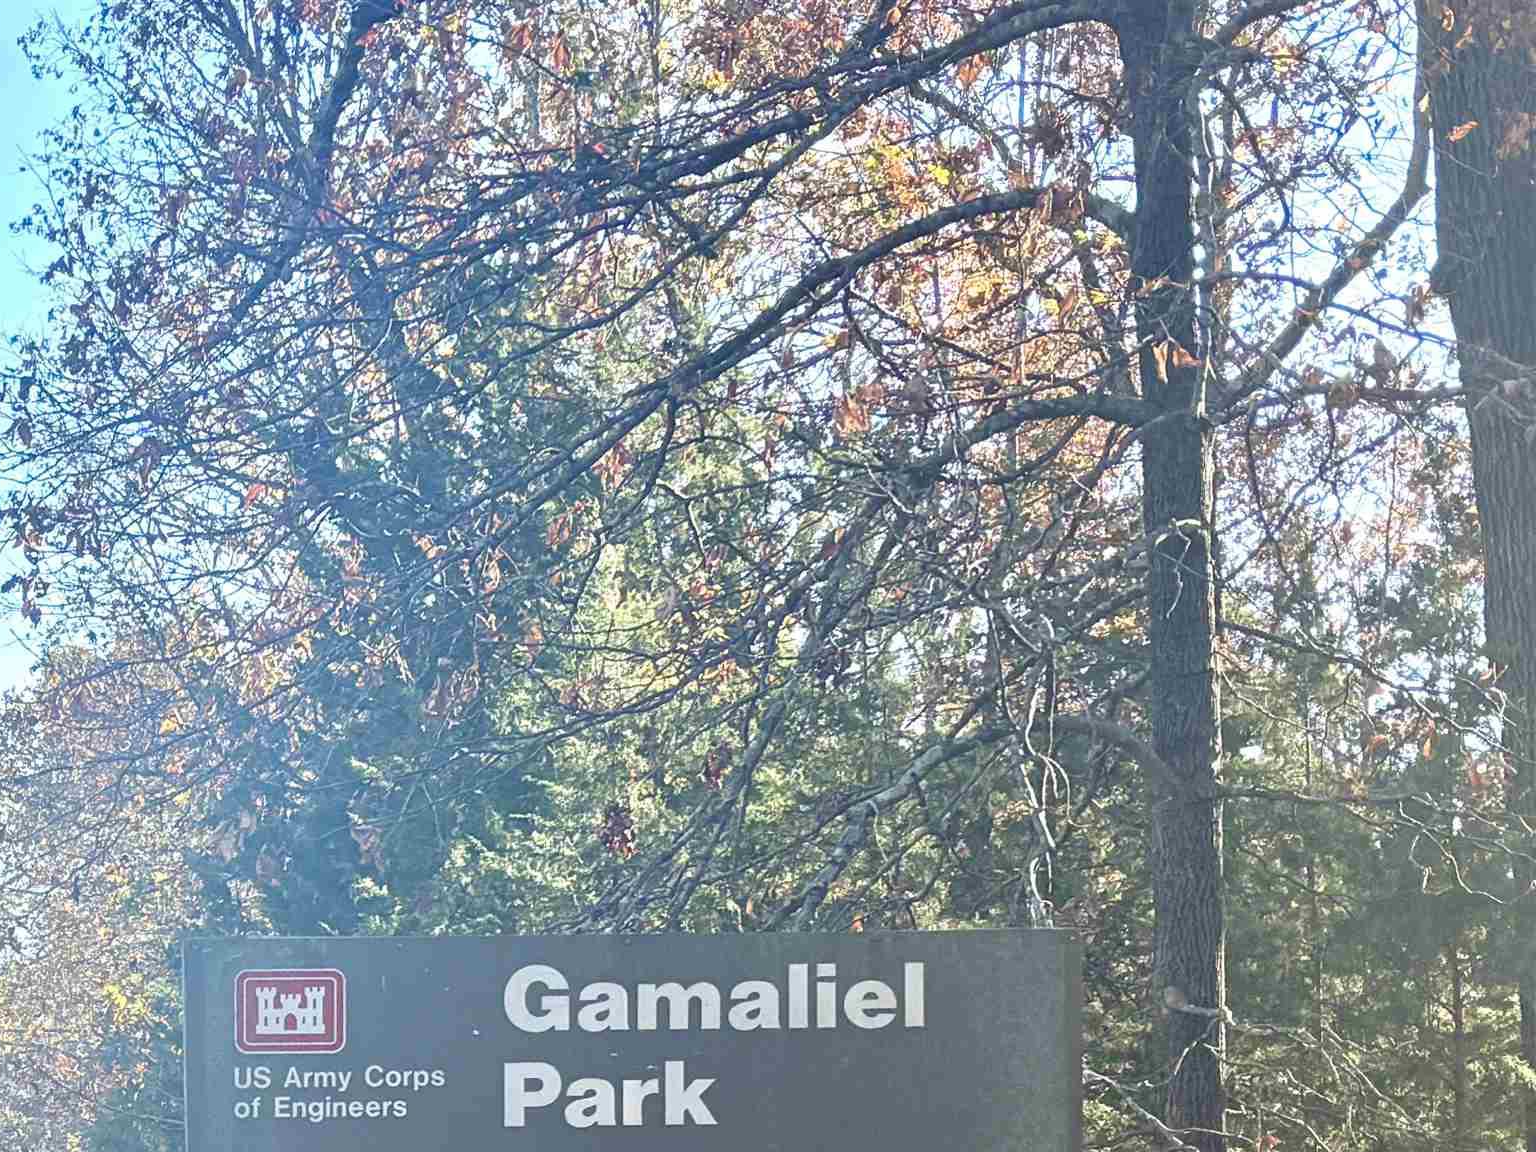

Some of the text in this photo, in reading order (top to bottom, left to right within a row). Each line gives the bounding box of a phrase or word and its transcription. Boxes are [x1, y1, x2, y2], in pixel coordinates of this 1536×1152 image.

[503, 962, 926, 1033] Gamaliel
[233, 1065, 446, 1092] US Army Corps
[503, 1060, 718, 1128] Park
[233, 1096, 408, 1122] of Engineers
